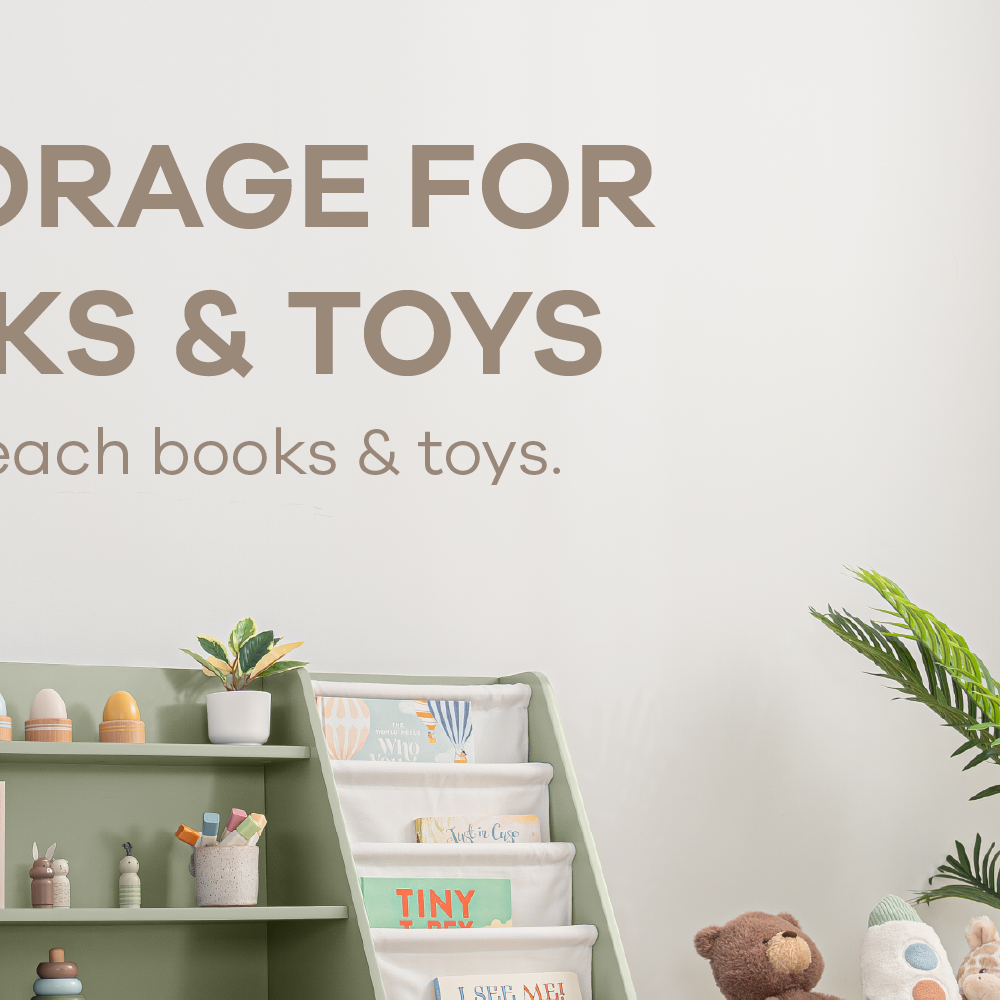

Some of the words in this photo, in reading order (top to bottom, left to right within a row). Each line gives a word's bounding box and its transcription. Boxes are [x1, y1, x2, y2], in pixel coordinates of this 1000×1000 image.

[378, 737, 420, 762] Who
[478, 827, 489, 839] in
[396, 889, 475, 918] TINY
